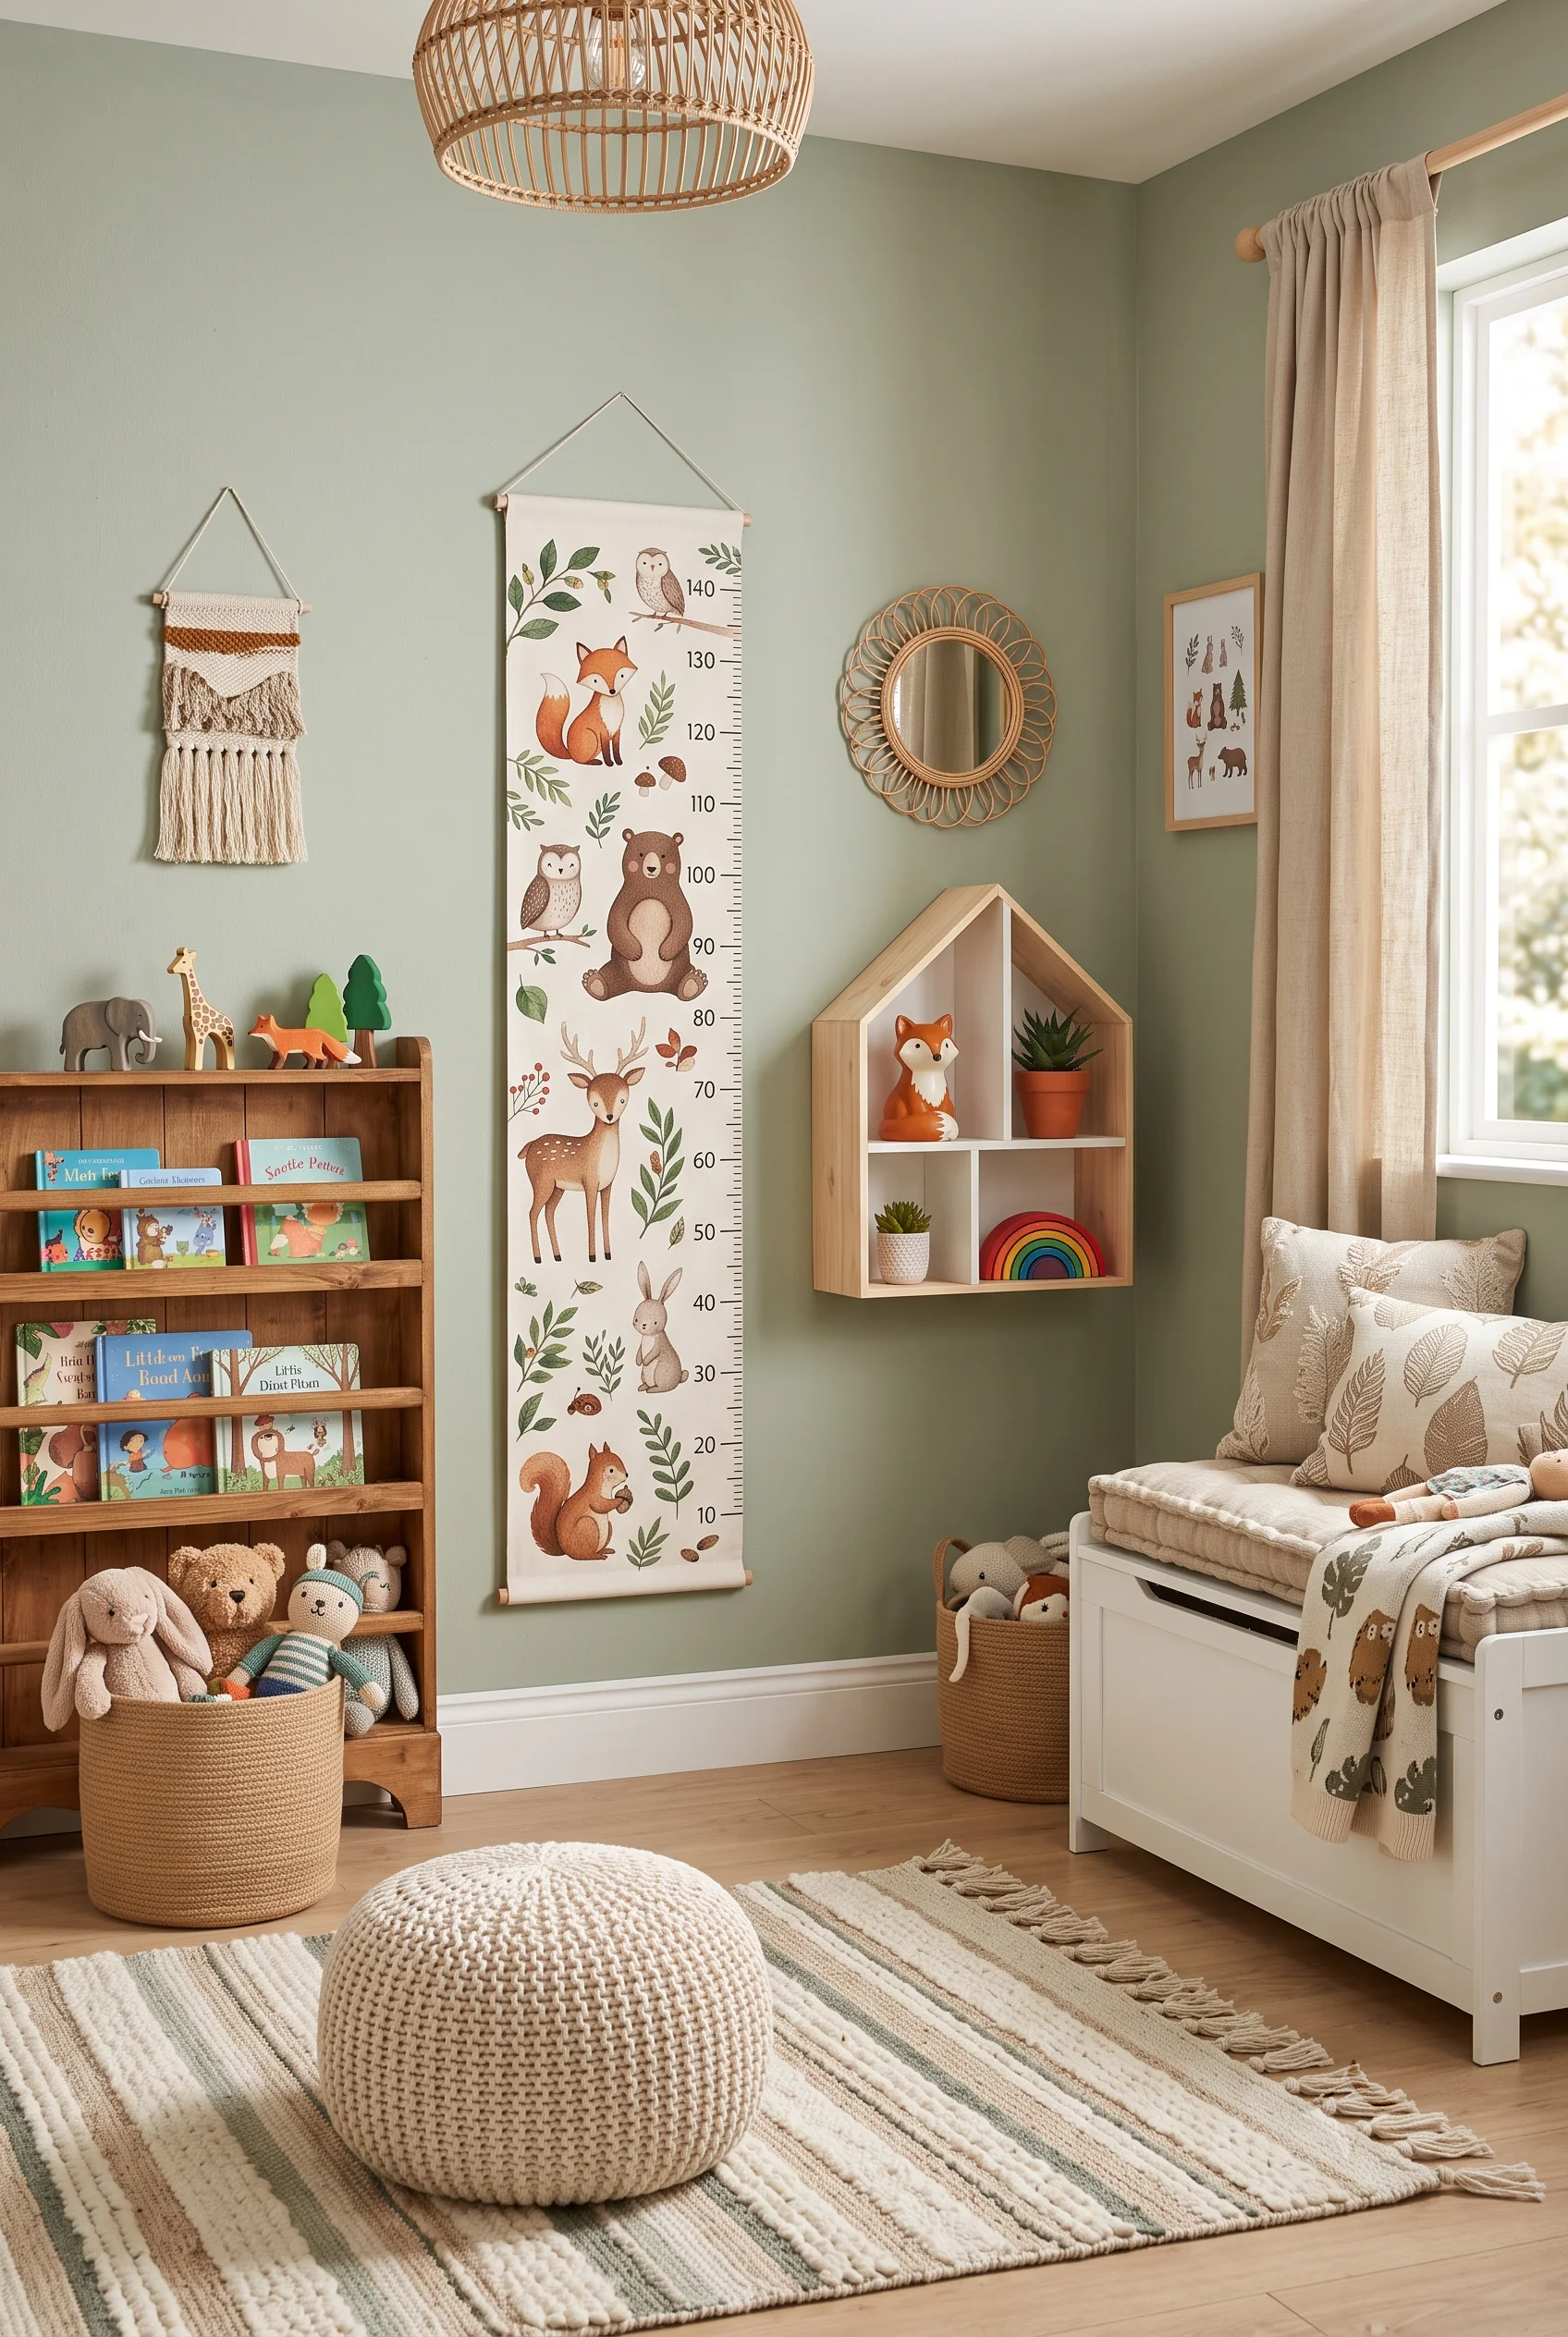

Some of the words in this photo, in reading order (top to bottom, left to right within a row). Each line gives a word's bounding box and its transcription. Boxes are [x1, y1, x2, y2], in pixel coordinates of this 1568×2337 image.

[687, 580, 715, 597] 140
[687, 651, 715, 668] 130
[687, 723, 715, 740] 120
[691, 795, 715, 813] 110
[687, 866, 715, 884] 100
[693, 937, 715, 955] 90
[693, 1009, 715, 1026] 80
[693, 1081, 715, 1098] 70
[693, 1152, 715, 1169] 60
[693, 1223, 715, 1241] 50
[693, 1294, 715, 1311] 40
[693, 1364, 715, 1383] 30
[693, 1437, 715, 1453] 20
[697, 1507, 716, 1523] 10
